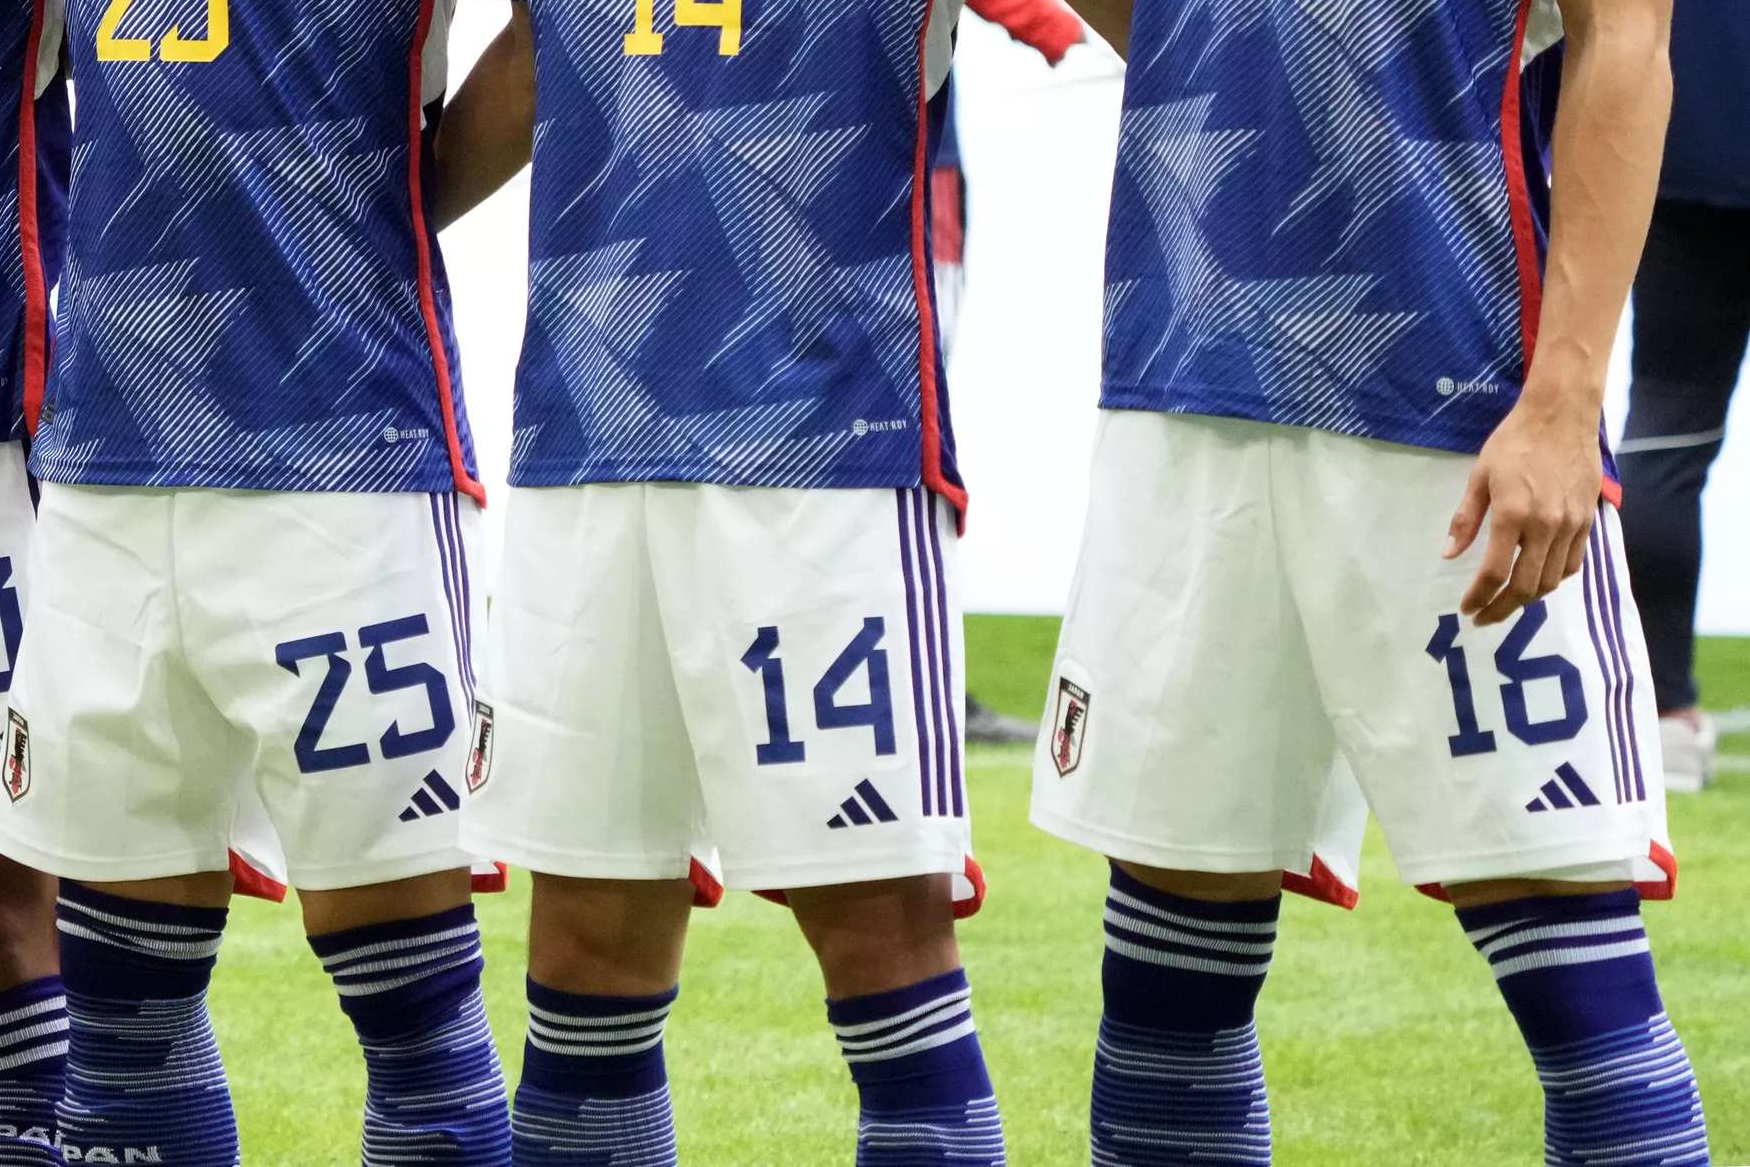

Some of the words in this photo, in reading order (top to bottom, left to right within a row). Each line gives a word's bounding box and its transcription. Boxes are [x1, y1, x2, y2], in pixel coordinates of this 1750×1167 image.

[276, 614, 455, 772] 25
[741, 617, 895, 764] 14
[1427, 601, 1587, 754] 16
